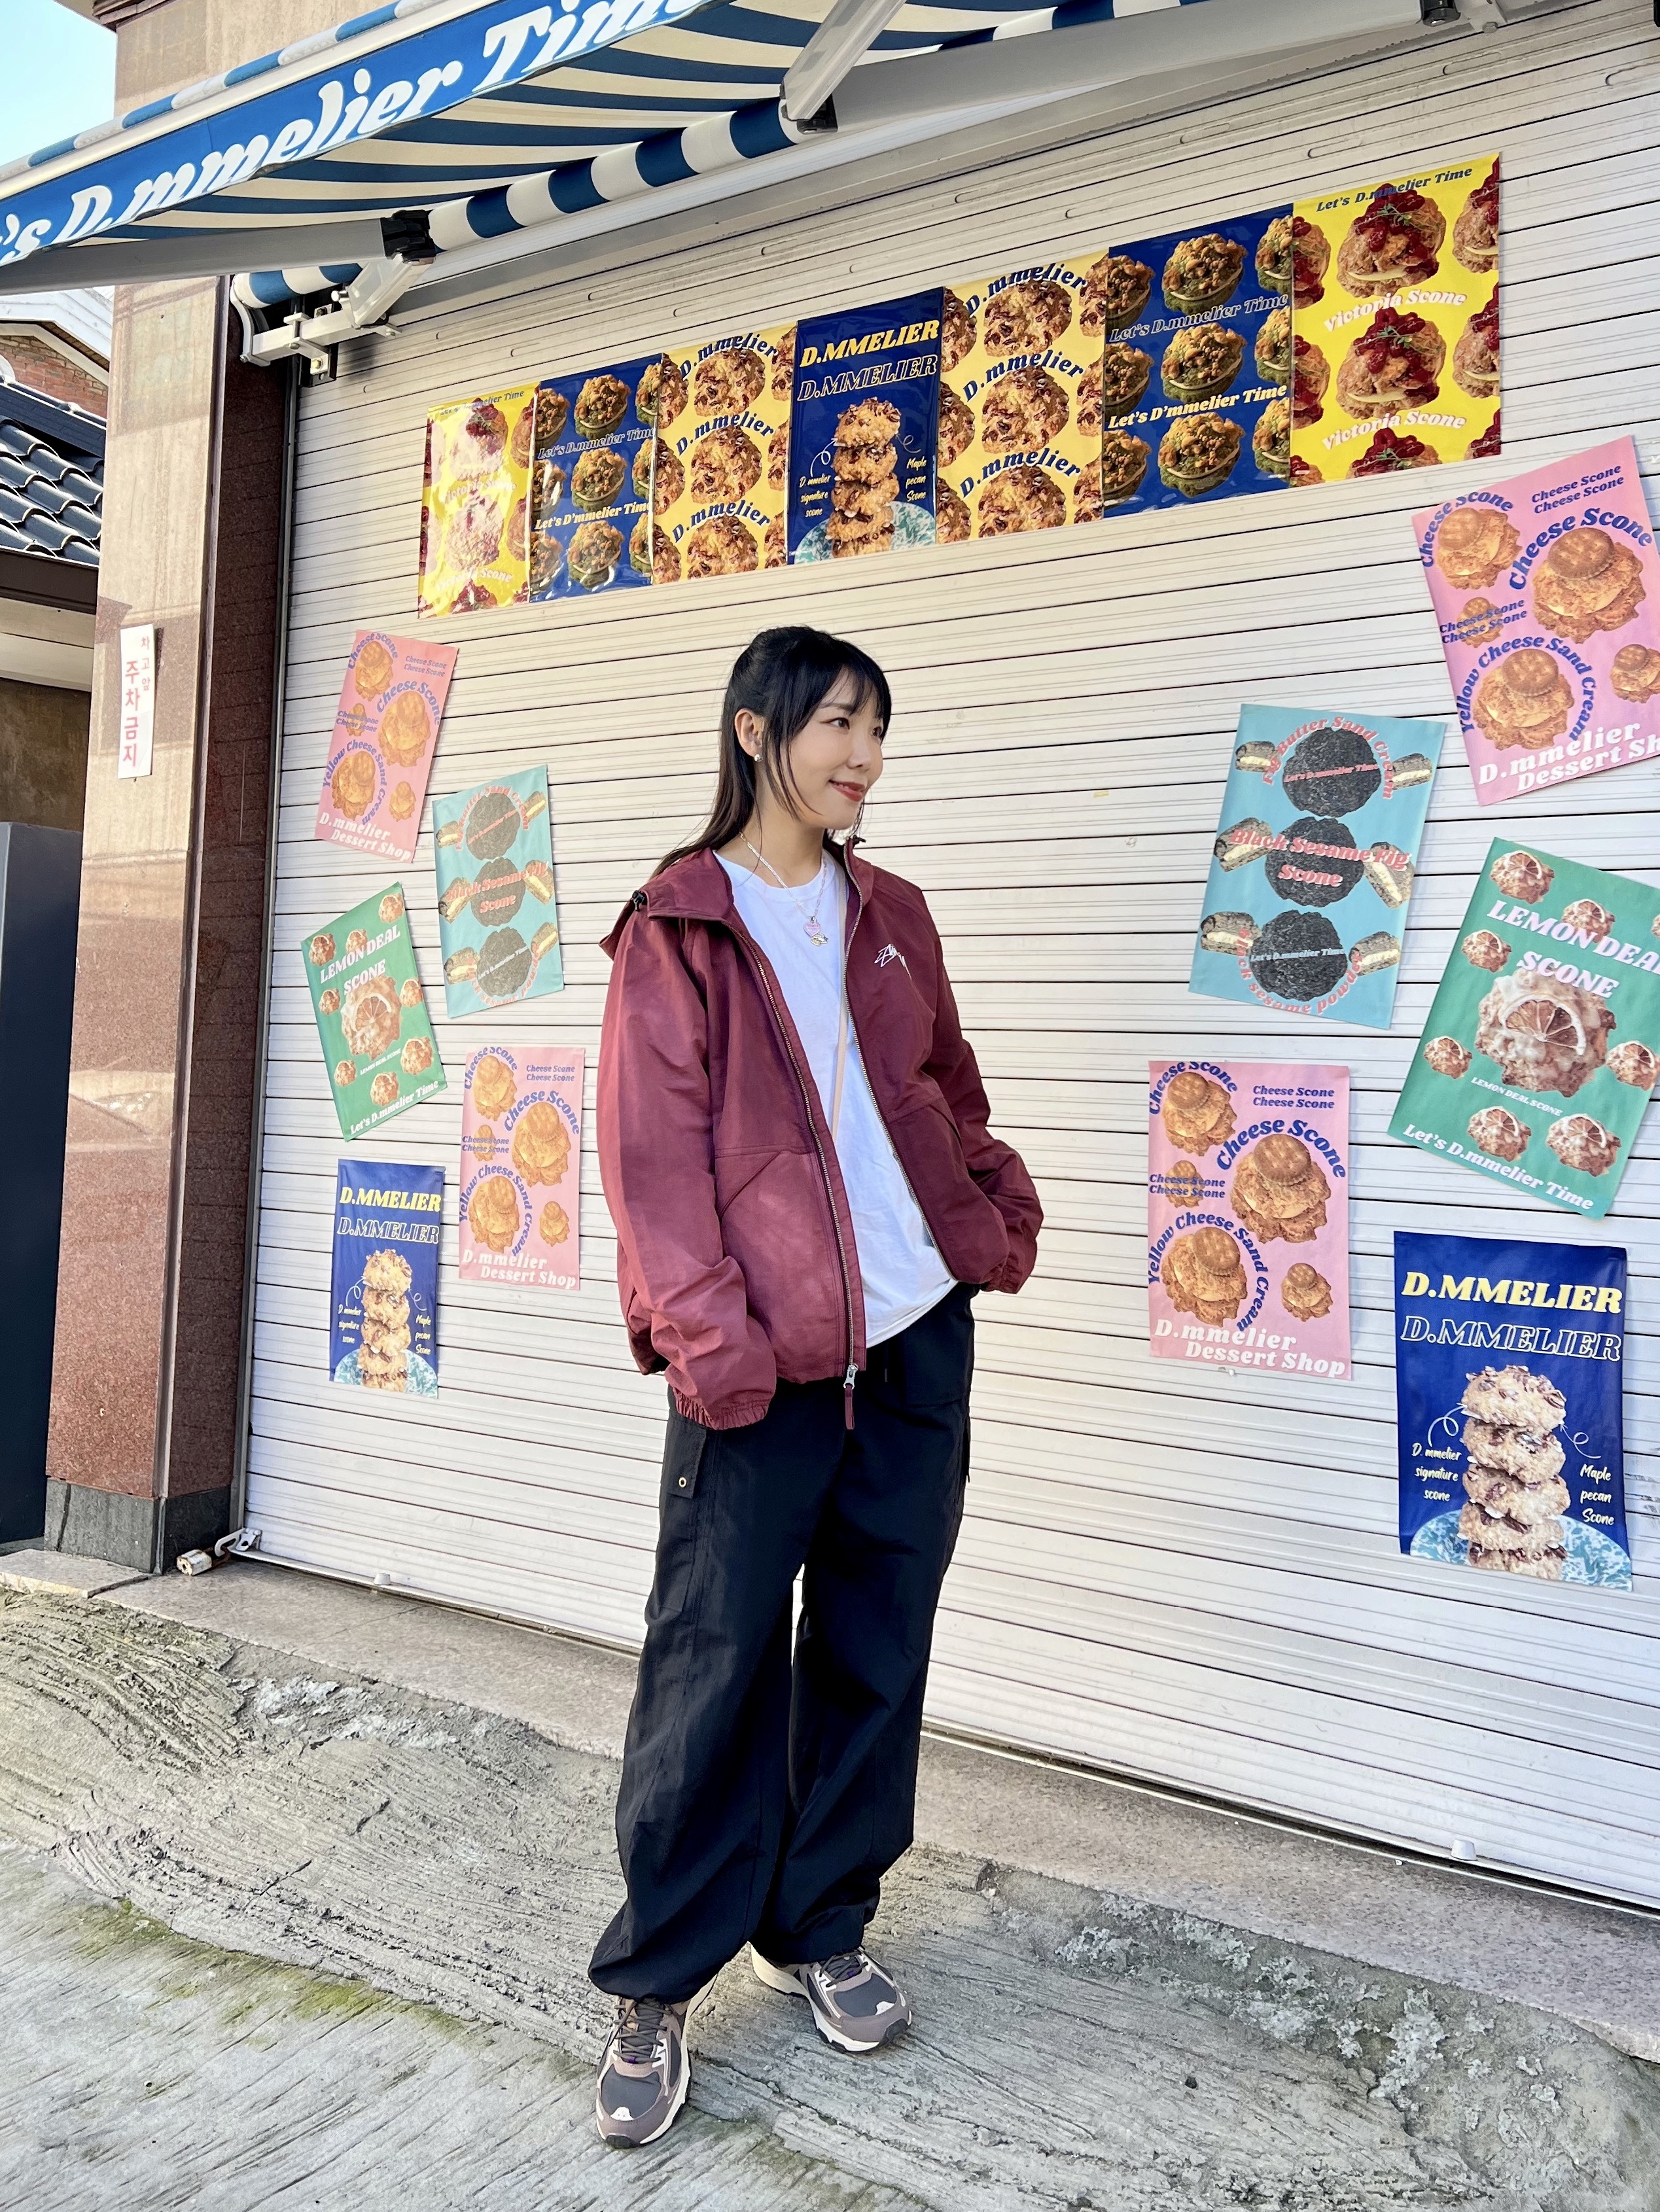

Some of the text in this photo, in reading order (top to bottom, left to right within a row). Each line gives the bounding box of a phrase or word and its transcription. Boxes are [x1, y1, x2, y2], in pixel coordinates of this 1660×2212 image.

[54, 61, 462, 245] D.mmelier
[472, 0, 711, 93] Tim
[1316, 166, 1474, 213] Let's D.mmelier Time
[965, 262, 1087, 317] D.mmelier
[1109, 292, 1289, 343] Let's D.mmelier Time
[1323, 289, 1468, 332] Victoria Scone
[680, 332, 779, 380] D.mmelier
[799, 319, 940, 368] D.MMELIER
[504, 390, 524, 400] Time
[797, 353, 938, 402] D.MMELIER
[962, 349, 1084, 402] D.mmelier
[1108, 383, 1288, 430] Let's D'mmelier Time
[675, 410, 775, 456] D.mmelier
[1321, 409, 1467, 451] Victoria Scone
[538, 445, 565, 459] Let's
[906, 457, 927, 470] Maple
[906, 476, 926, 491] pecan
[959, 447, 1082, 500] D.mmelier
[1532, 465, 1621, 503] Cheese Scone
[800, 491, 828, 504] signature
[805, 508, 823, 518] scone
[906, 489, 926, 502] Scone
[1534, 476, 1624, 514] Cheese Scone
[534, 516, 562, 530] Let's
[672, 499, 771, 544] D.mmelier
[1421, 491, 1513, 567] Cheese Scone
[1510, 508, 1653, 590] Cheese Scone
[1439, 599, 1525, 634] Cheese Scone
[1441, 610, 1528, 644] Cheese Scone
[348, 633, 398, 669] Cheese Scone
[404, 664, 445, 676] Cheese Scone
[406, 656, 447, 669] Cheese Scone
[377, 680, 441, 724] Cheese Scone
[1457, 636, 1597, 741] Yellow Cheese Sand Cream
[123, 659, 140, 767] 주차금지
[1277, 719, 1328, 755] Butter
[1331, 716, 1378, 741] Sand
[1374, 741, 1394, 799] Cream
[1478, 723, 1641, 785] D.mmelier
[1517, 746, 1623, 792] Dessert
[323, 739, 387, 825] Yellow Cheese Sand Cream
[319, 812, 391, 841] D.mmelier
[330, 828, 412, 862] Dessert Shop
[1231, 828, 1412, 871] Black Sesame Fig
[448, 871, 527, 902] Black Sesame
[1277, 864, 1343, 887] Scone
[480, 894, 516, 913] Scone
[1487, 899, 1598, 950] LEMON
[319, 925, 400, 983] LEMON DEAL
[1250, 953, 1272, 962] Let's
[1321, 947, 1345, 956] Time
[344, 959, 386, 995] SCONE
[1517, 949, 1620, 999] SCONE
[1249, 982, 1312, 1013] sesame
[465, 1047, 517, 1089] Cheese Scone
[350, 1080, 439, 1135] Let's D.mmelier Time
[1149, 1061, 1238, 1115] Cheese Scone
[1253, 1085, 1335, 1097] Cheese Scone
[1253, 1097, 1335, 1109] Cheese Scone
[1471, 1076, 1563, 1117] LEMON DEAL SCONE
[504, 1091, 579, 1134] Cheese Scone
[1217, 1119, 1346, 1178] Cheese Scone
[1403, 1123, 1595, 1211] Let's D.mmelier Time
[340, 1187, 441, 1212] D.MMELIER
[1149, 1174, 1226, 1187] Cheese Scone
[1149, 1185, 1226, 1199] Cheese Scone
[459, 1165, 533, 1256] Yellow Cheese Sand Cream
[337, 1218, 439, 1244] D.MMELIER
[462, 1249, 547, 1270] D.mmelier
[481, 1266, 576, 1290] Dessert Shop
[1148, 1212, 1269, 1332] Yellow Cheese Sand Cream
[1401, 1271, 1623, 1314] D.MMELIER
[1154, 1318, 1296, 1351] D.mmelier
[1400, 1315, 1623, 1361] D.MMELIER
[1185, 1342, 1345, 1378] Dessert Shop
[1415, 1466, 1458, 1483] signature
[1580, 1464, 1611, 1482] Maple
[1423, 1488, 1450, 1502] scone
[1580, 1490, 1612, 1505] pecan
[1581, 1508, 1615, 1526] Scone
